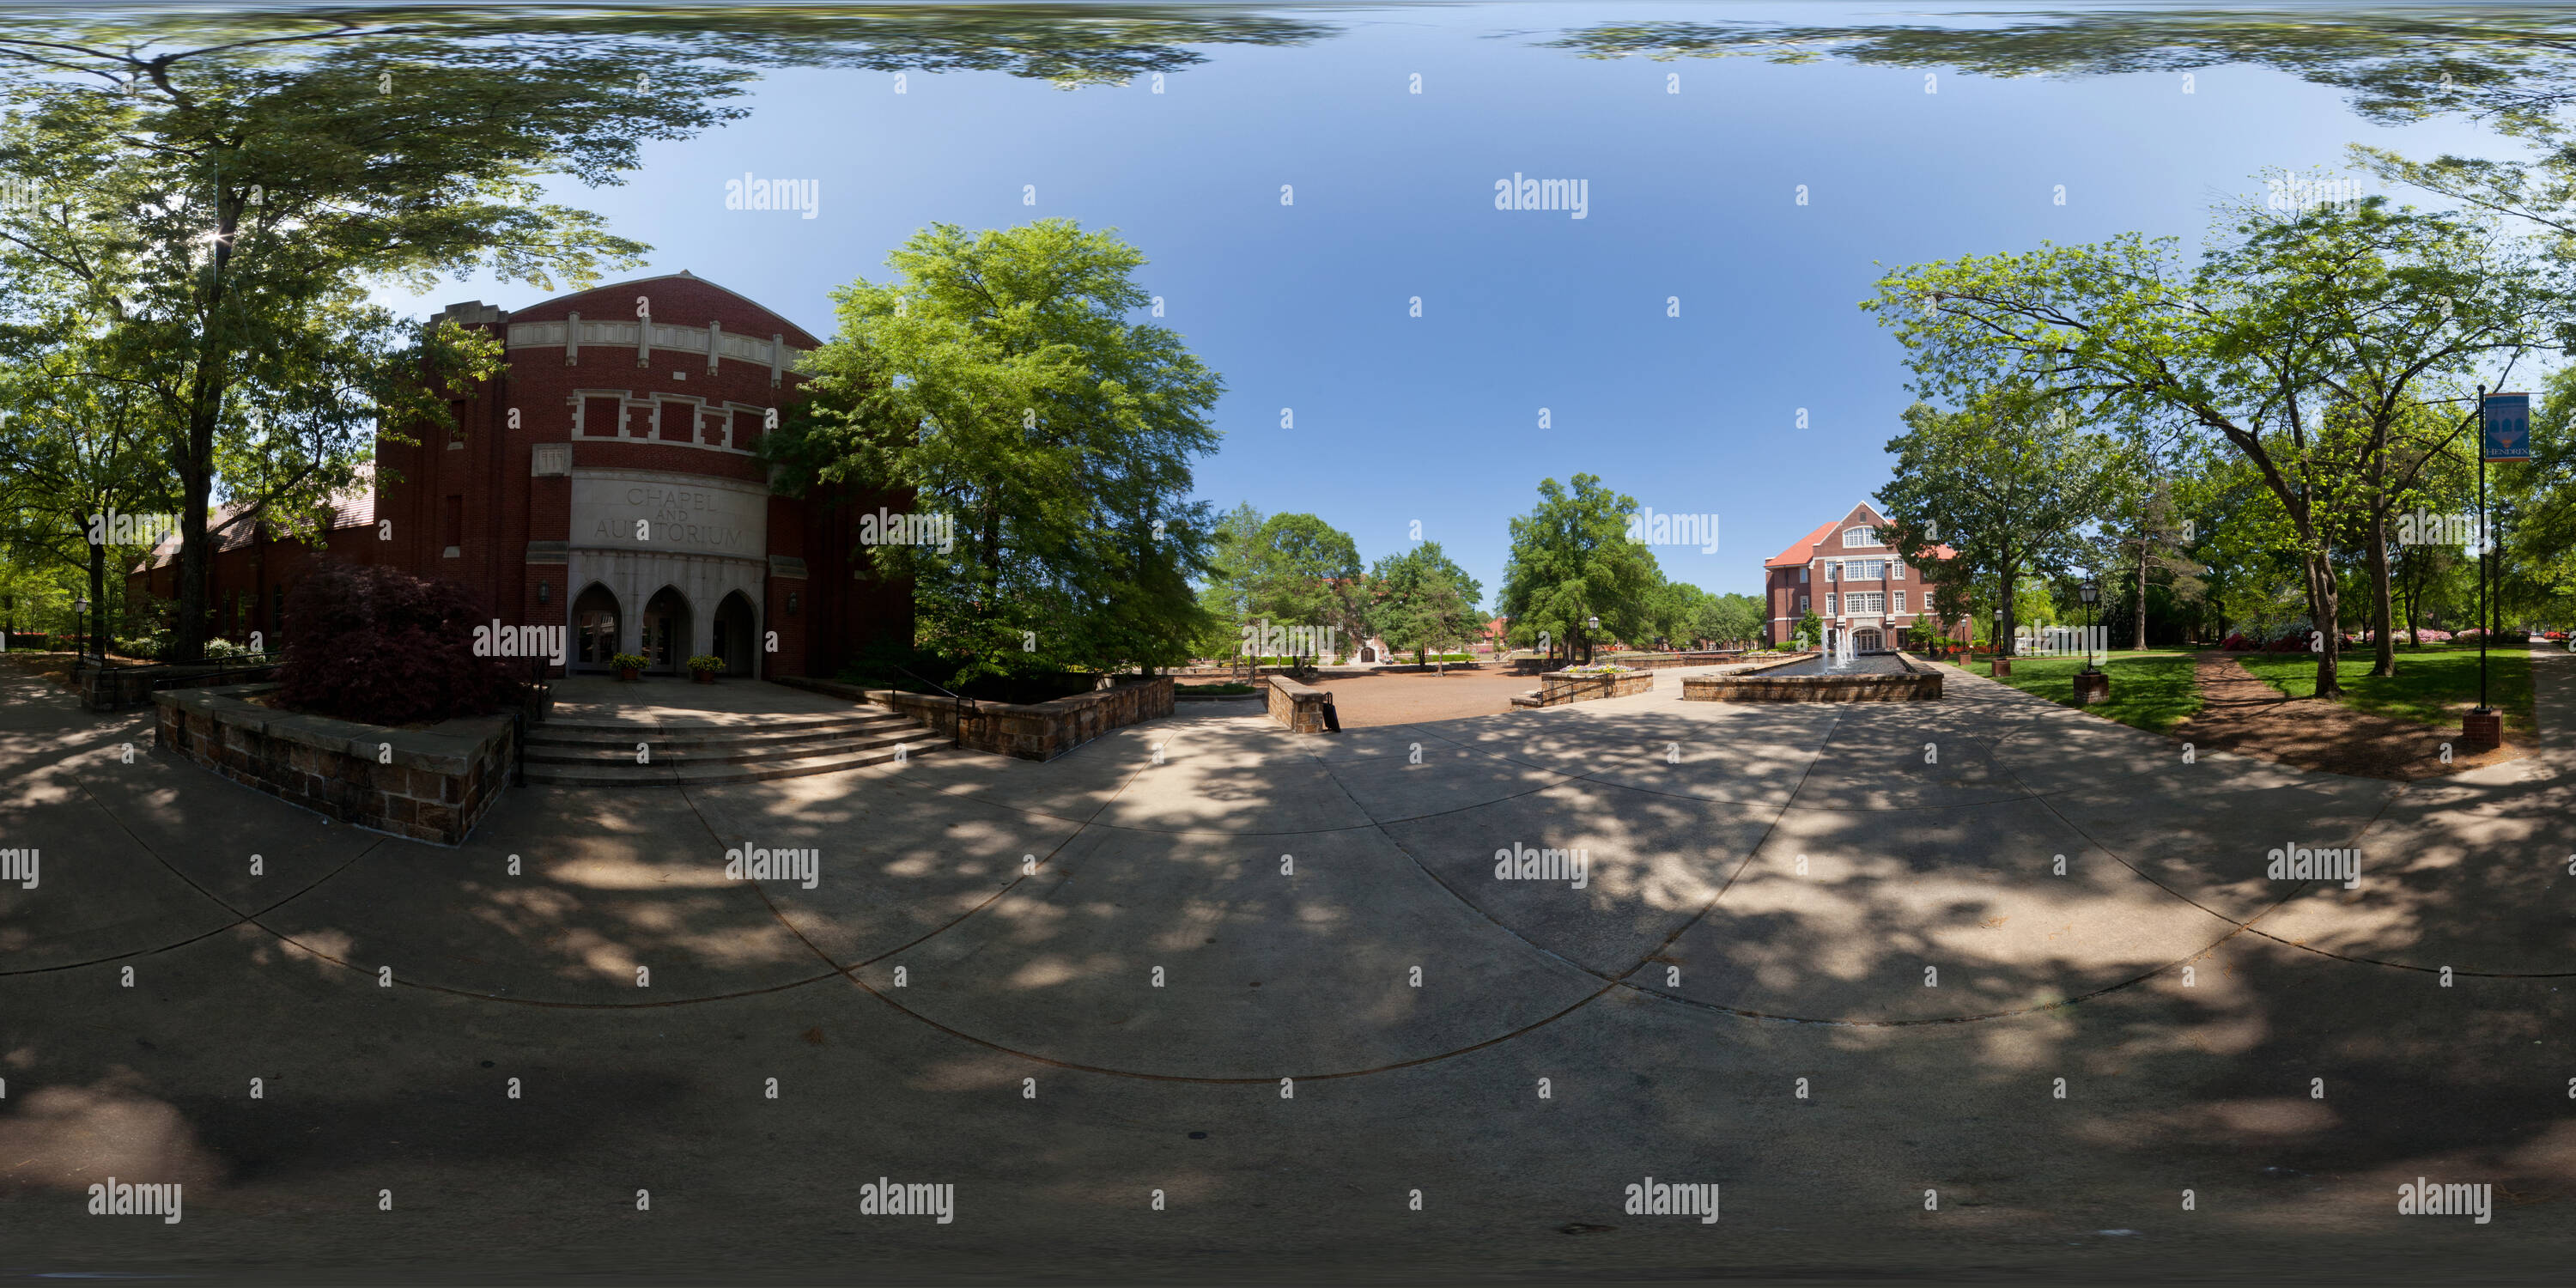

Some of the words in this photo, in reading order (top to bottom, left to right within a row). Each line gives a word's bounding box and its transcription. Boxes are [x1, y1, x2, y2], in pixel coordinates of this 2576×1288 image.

[2486, 447, 2529, 456] HENDRIX
[627, 488, 718, 512] CHAPEL
[655, 509, 689, 522] AND
